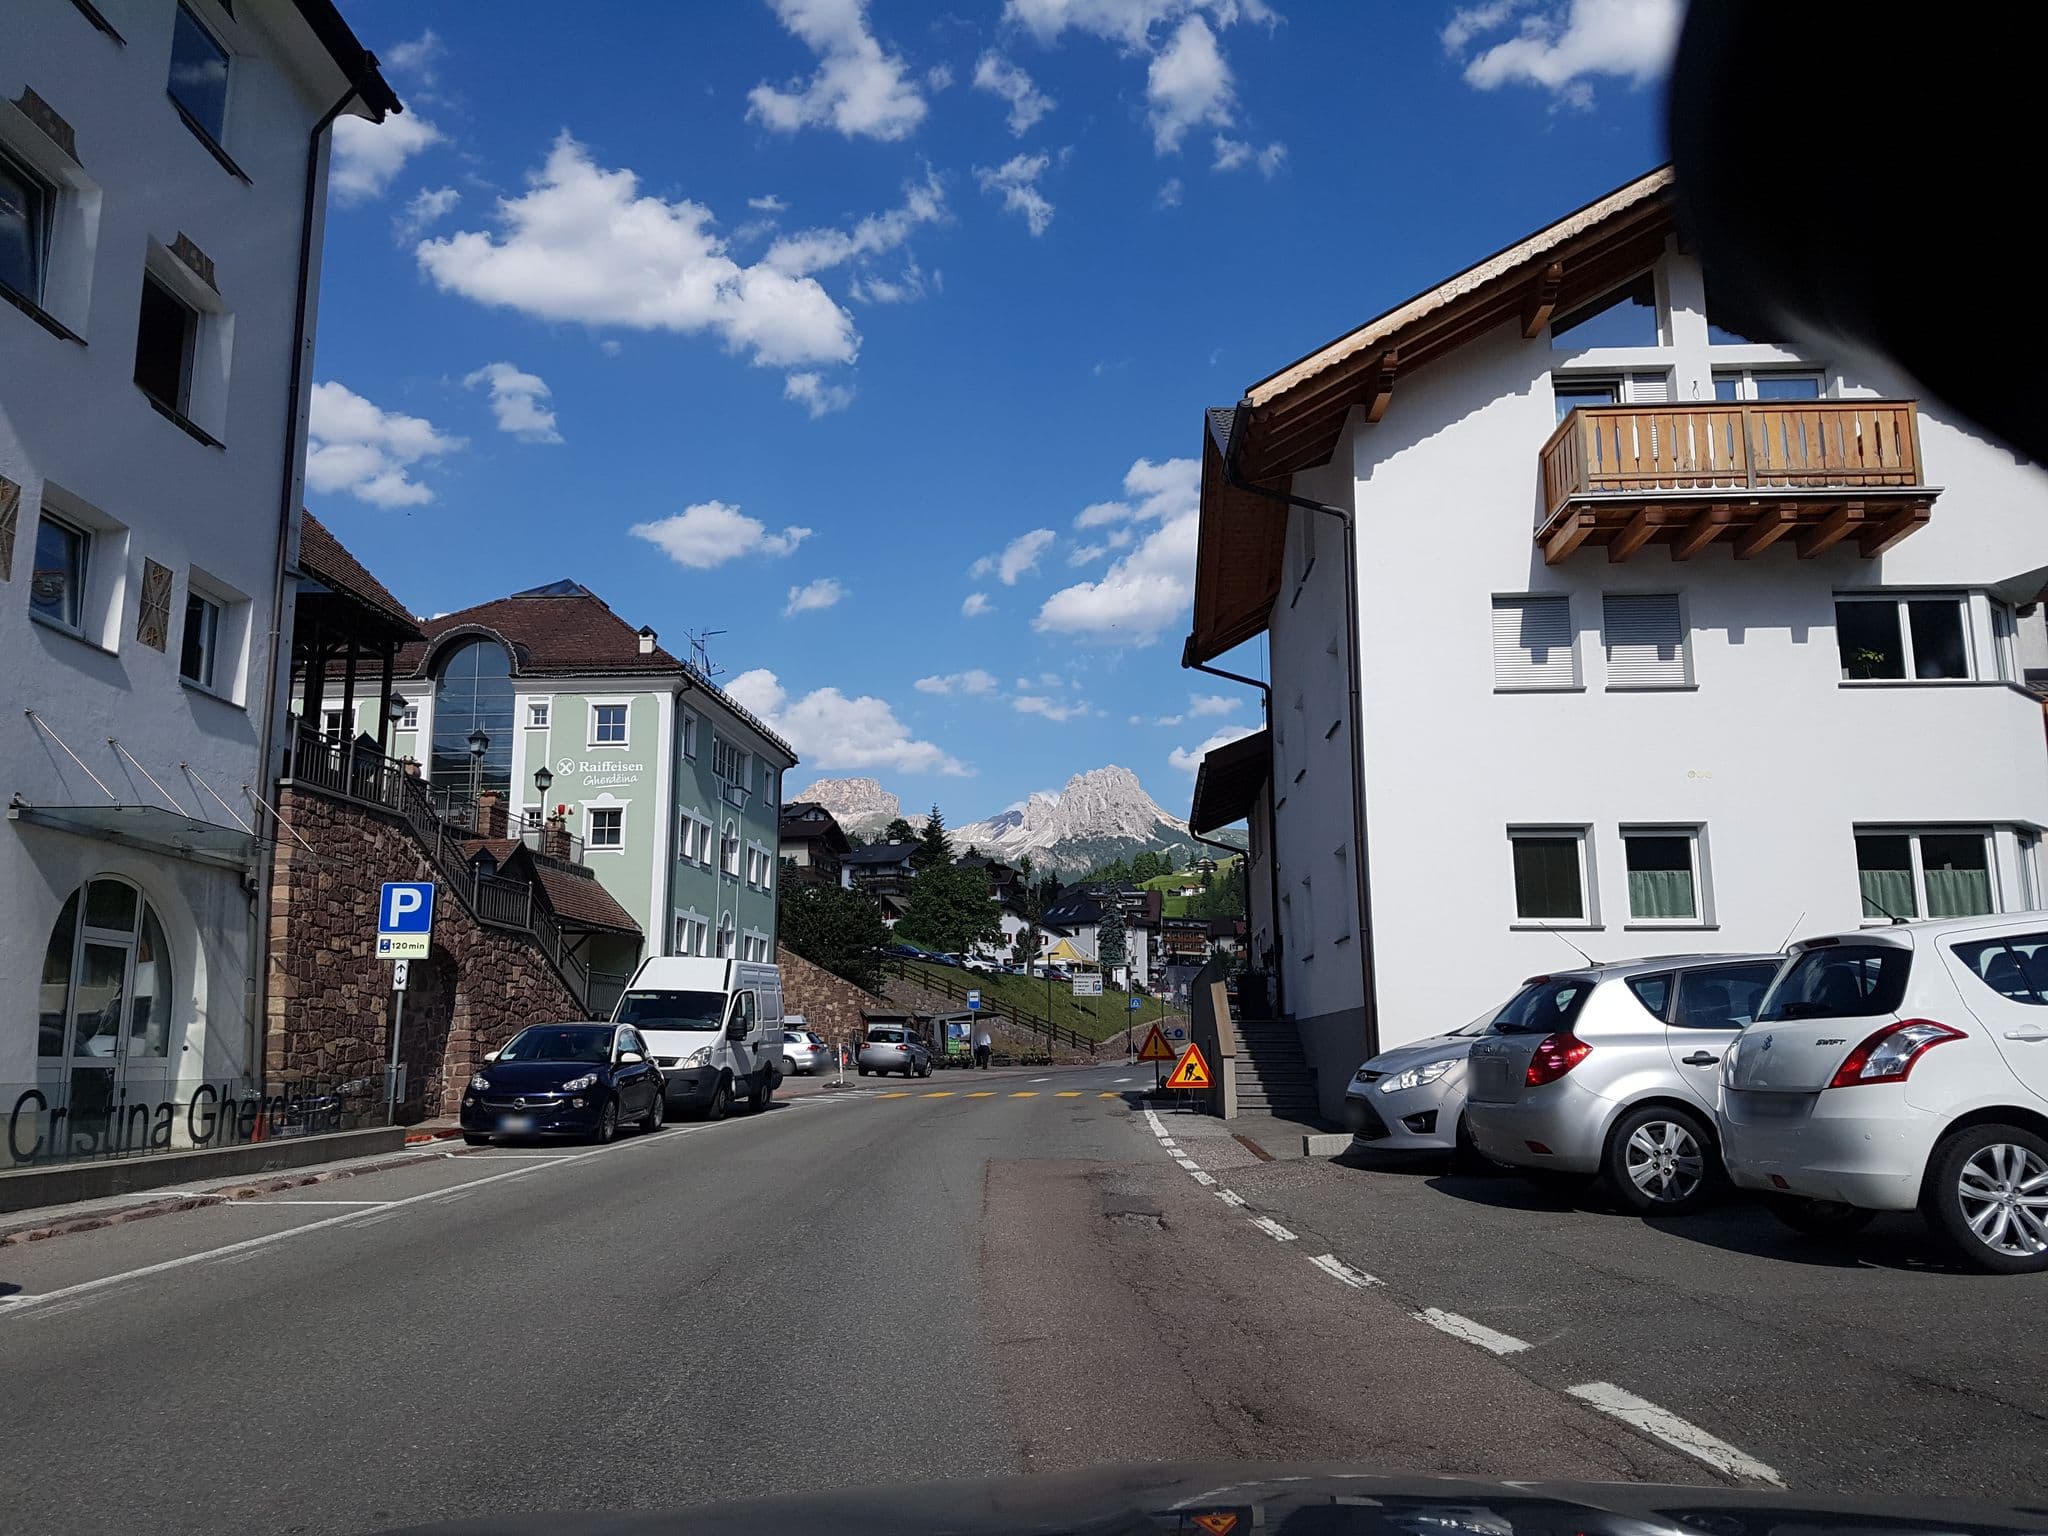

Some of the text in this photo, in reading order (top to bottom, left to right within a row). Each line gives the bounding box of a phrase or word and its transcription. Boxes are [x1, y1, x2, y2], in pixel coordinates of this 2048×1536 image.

[578, 761, 643, 772] Raiffeisen
[389, 888, 422, 928] P
[392, 942, 425, 950] 120 min
[1816, 1038, 1847, 1046] SWIFT
